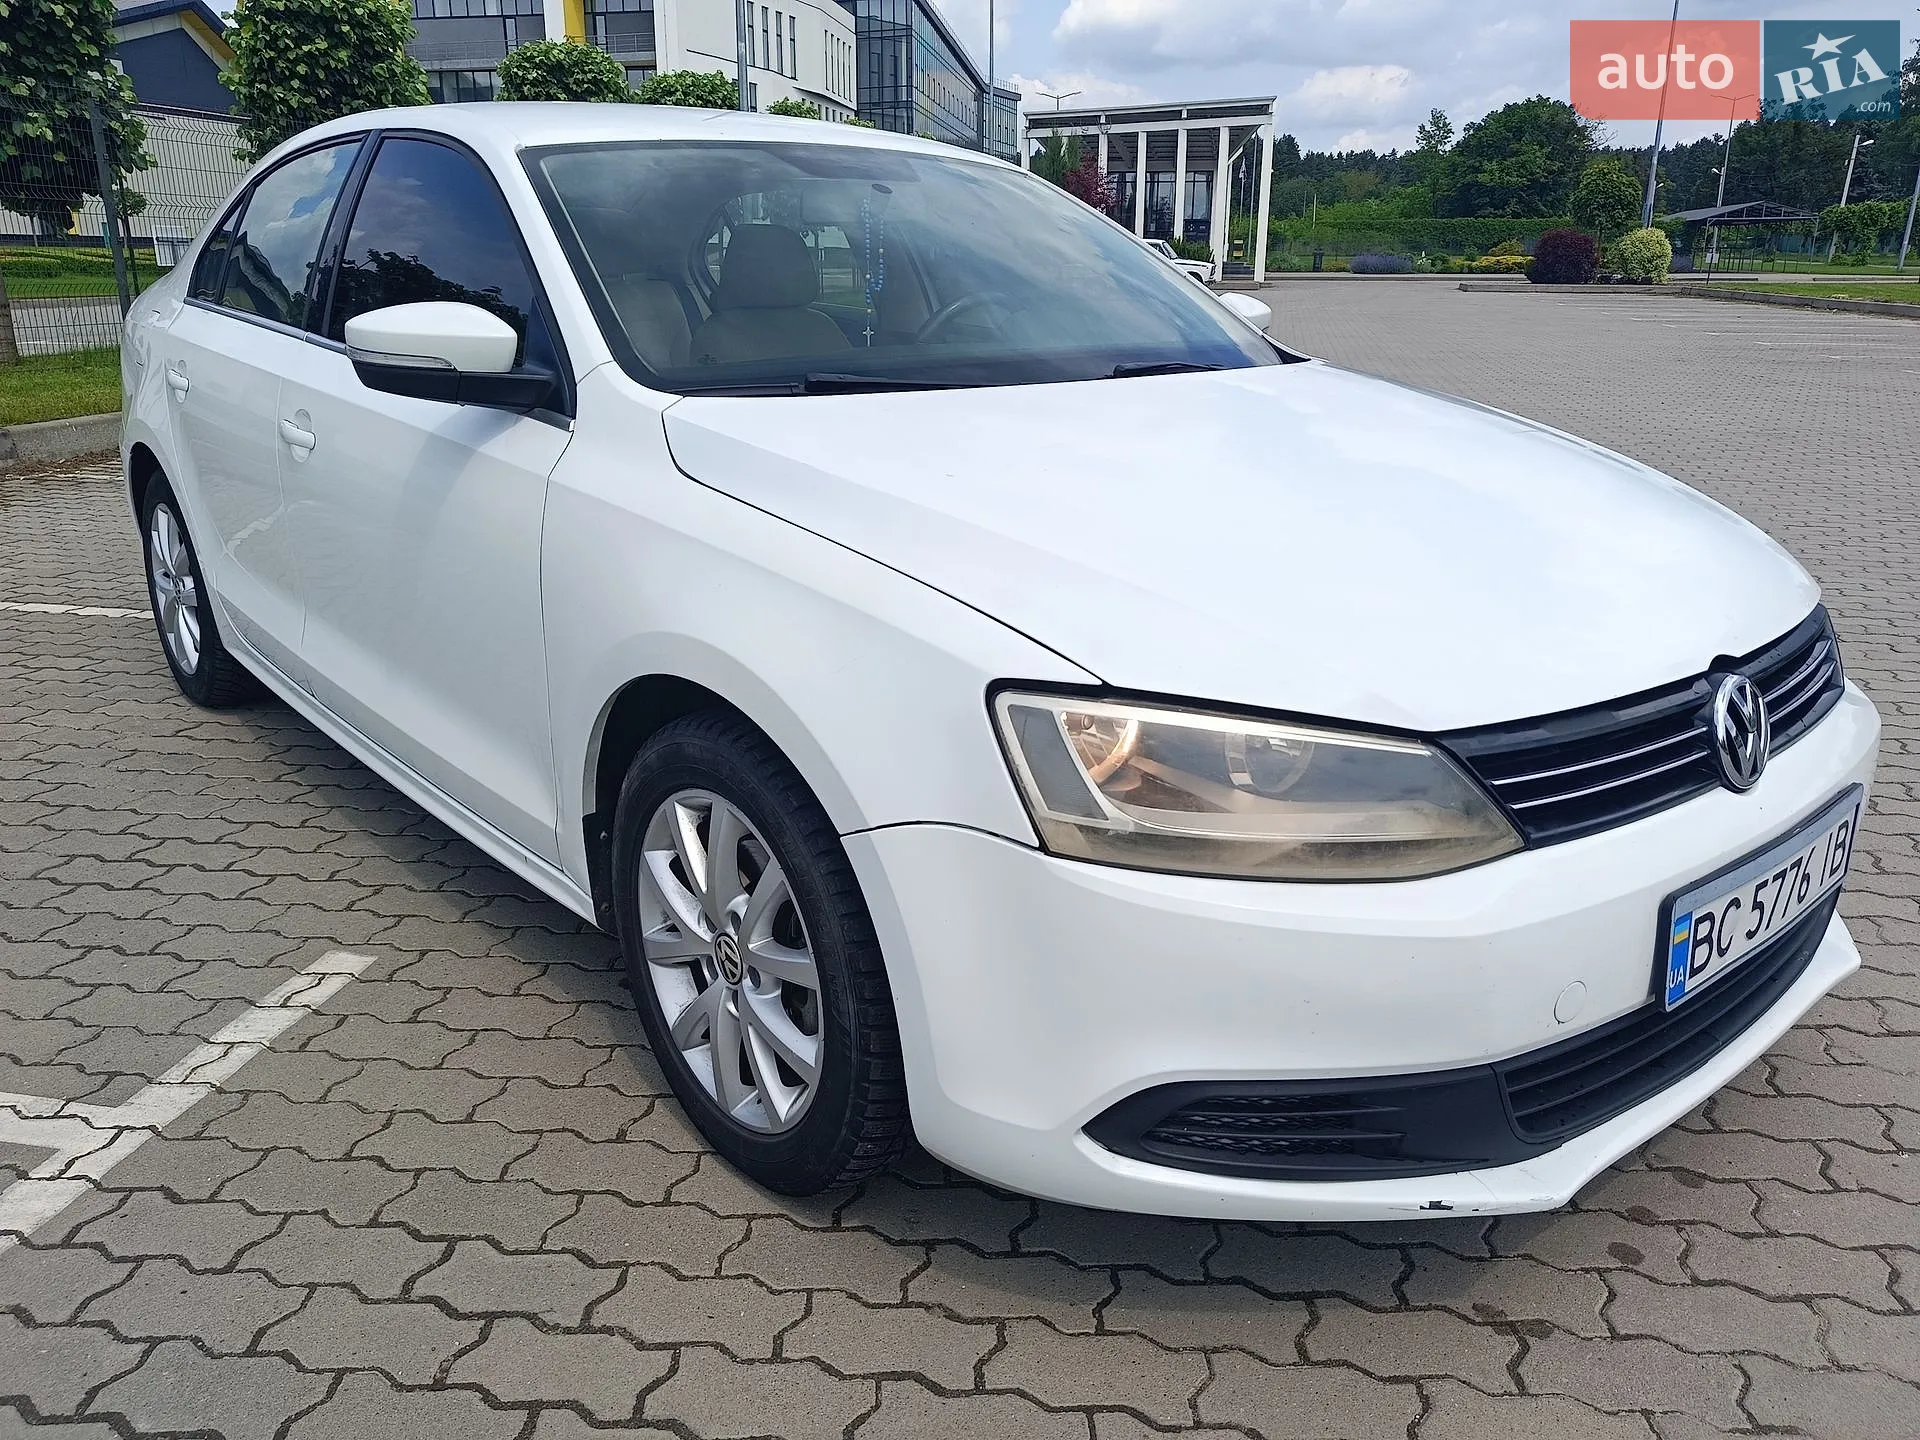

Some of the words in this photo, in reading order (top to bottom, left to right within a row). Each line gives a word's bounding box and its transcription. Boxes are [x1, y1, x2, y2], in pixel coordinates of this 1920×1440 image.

[1688, 896, 1742, 981] BC
[1745, 846, 1817, 940] 5776
[1819, 819, 1850, 887] IB
[1669, 964, 1685, 988] UA
